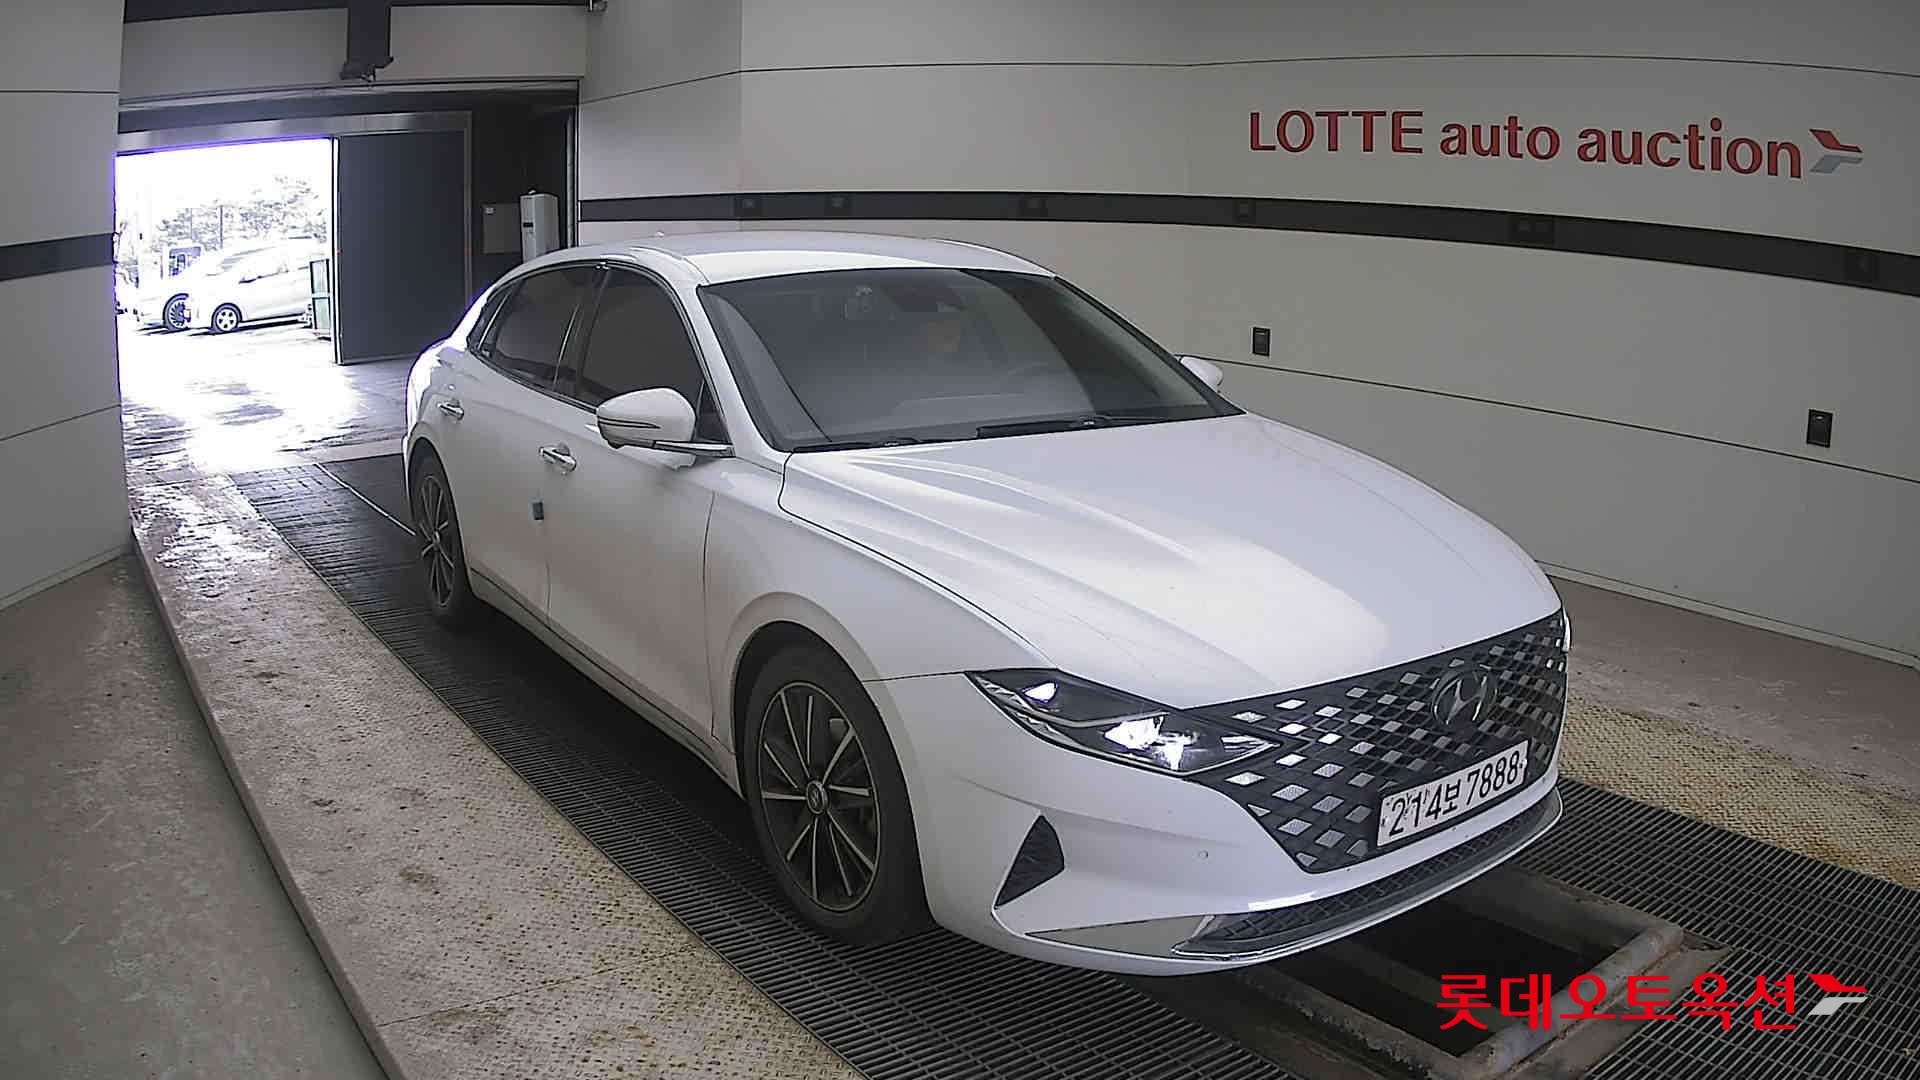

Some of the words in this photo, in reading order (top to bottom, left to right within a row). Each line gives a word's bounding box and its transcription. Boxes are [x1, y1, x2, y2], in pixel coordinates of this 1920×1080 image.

[1249, 110, 1424, 154] LOTTE
[1439, 115, 1561, 161] auto
[1577, 117, 1802, 178] auction
[1389, 779, 1461, 837] 214보
[1466, 750, 1521, 806] 7888
